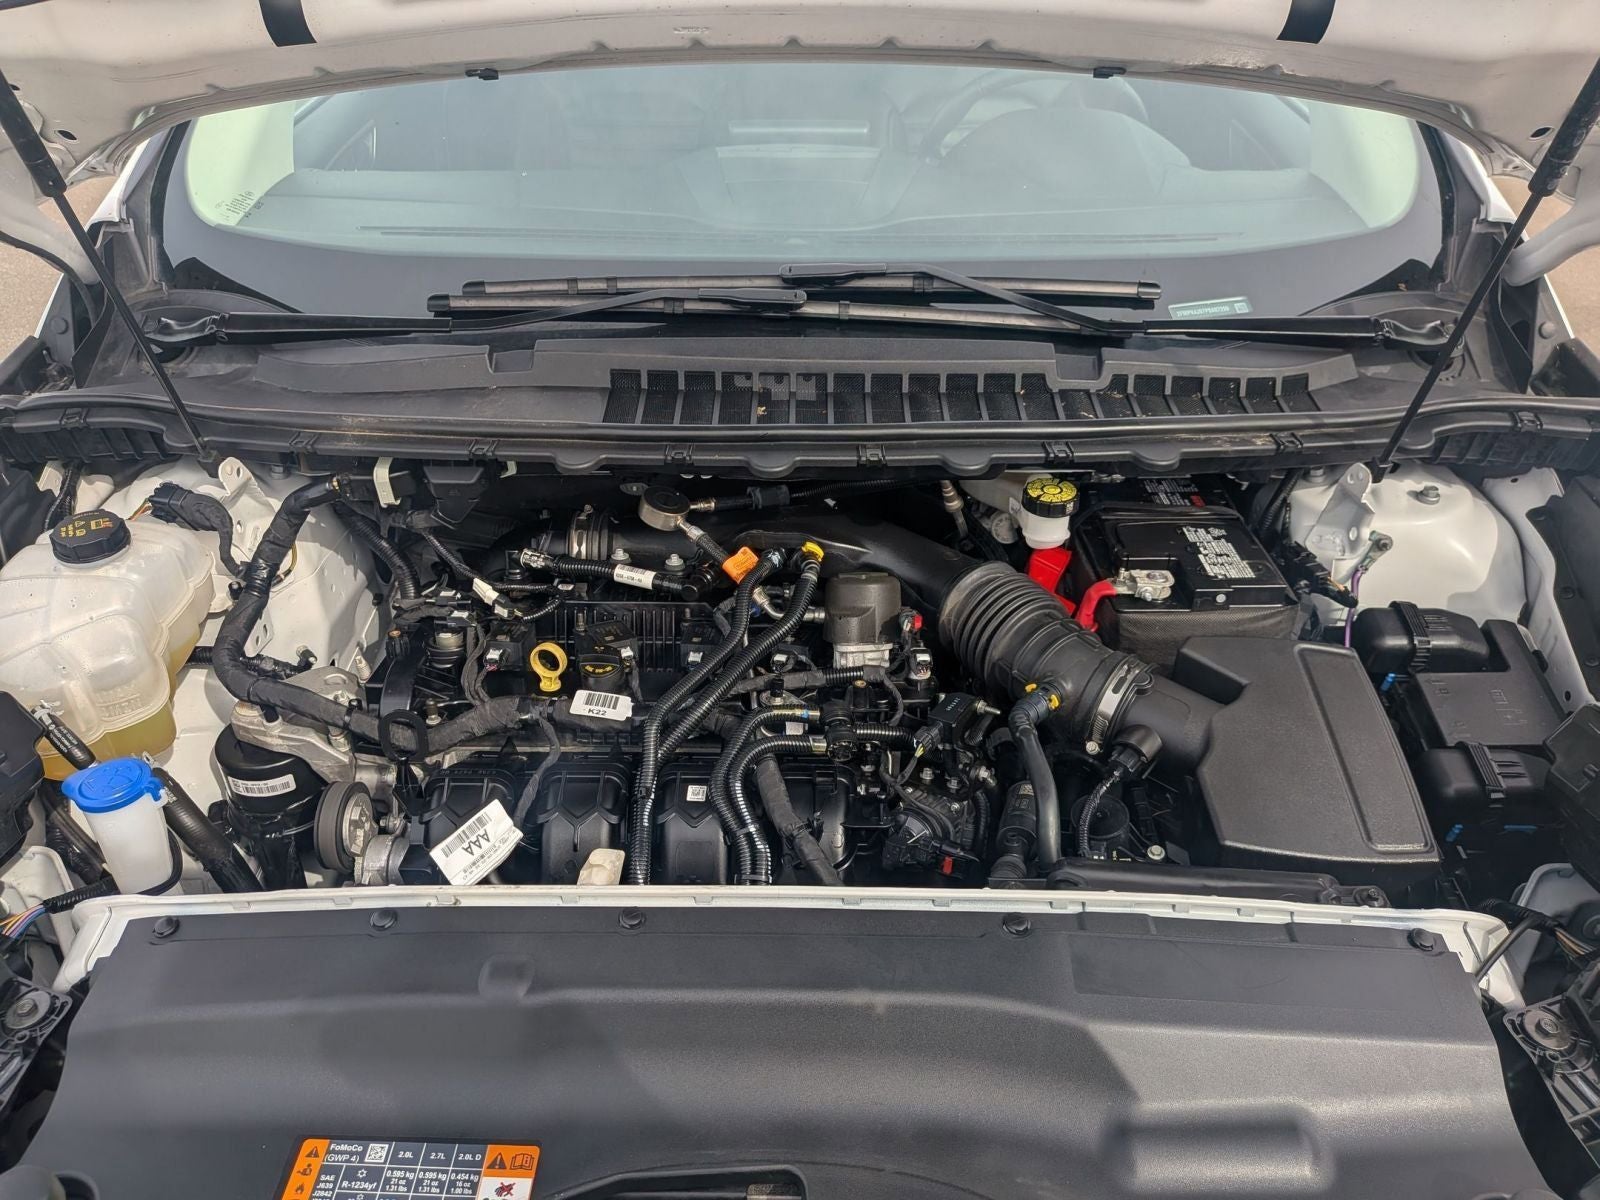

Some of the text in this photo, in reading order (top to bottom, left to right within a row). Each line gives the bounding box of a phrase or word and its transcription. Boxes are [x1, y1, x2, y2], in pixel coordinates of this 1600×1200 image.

[462, 828, 490, 856] AAA
[330, 1144, 364, 1152] FoMoCo
[324, 1154, 360, 1164] (GWP 4)
[405, 1171, 415, 1180] kg
[438, 1172, 447, 1180] kg
[470, 1174, 479, 1182] kg
[341, 1180, 377, 1192] R-1234yf
